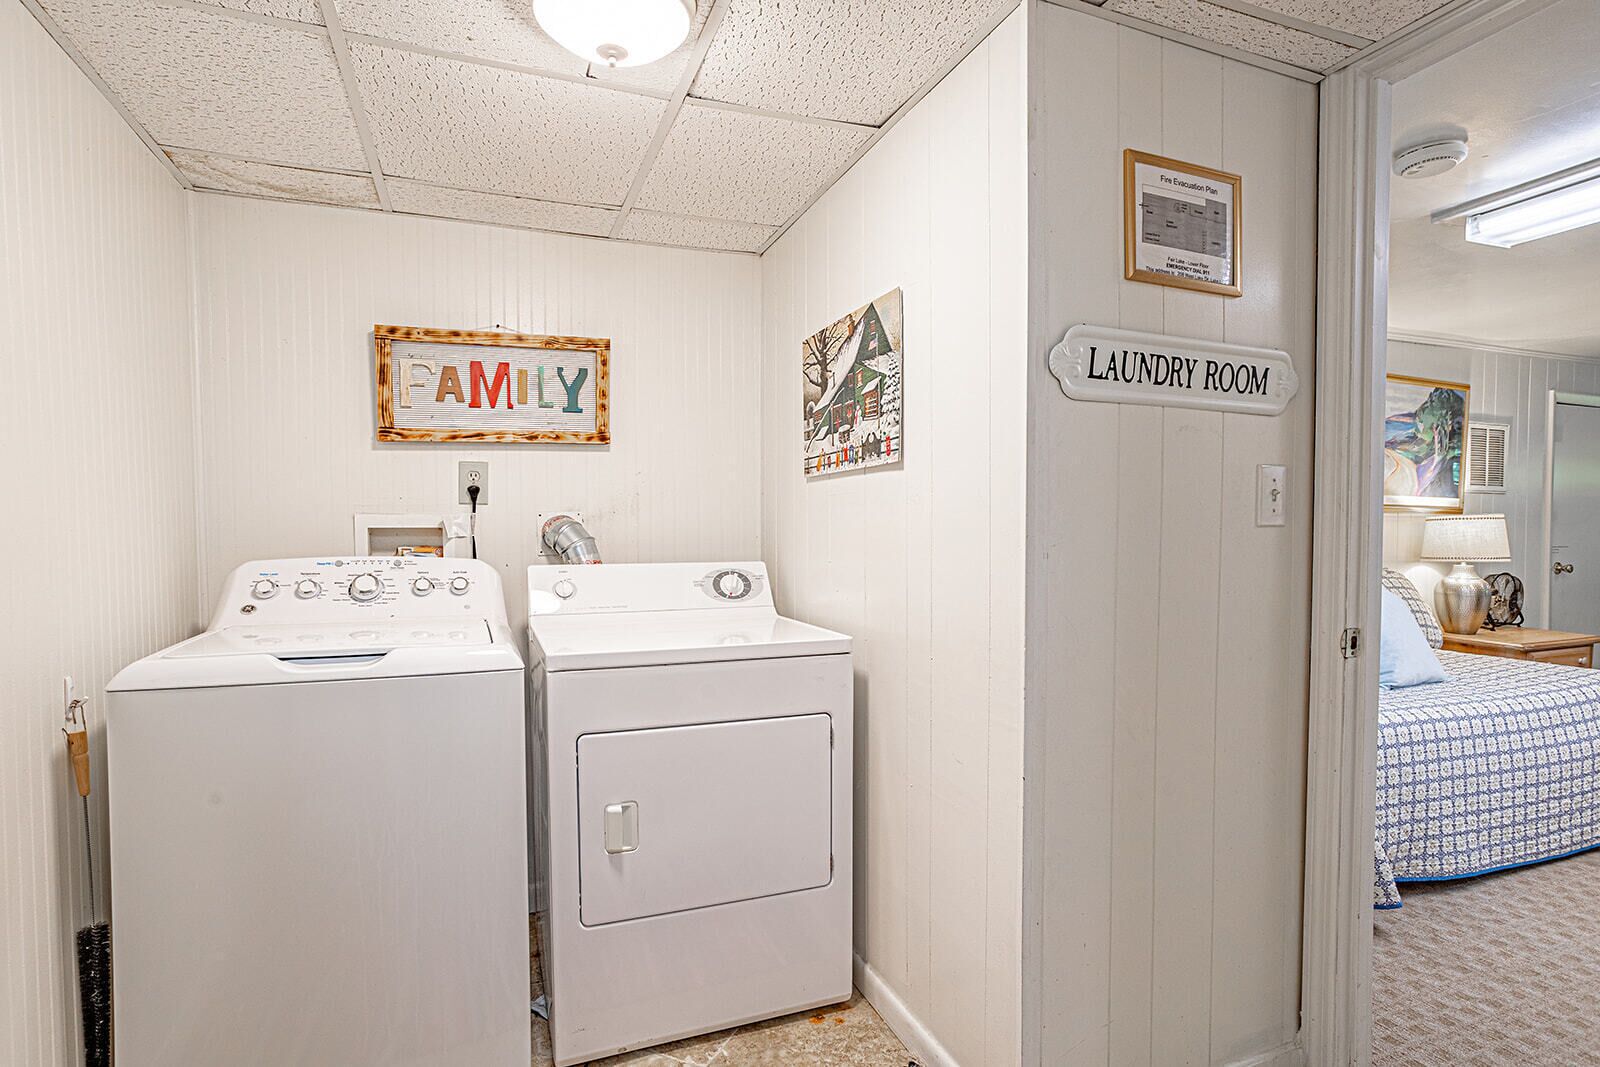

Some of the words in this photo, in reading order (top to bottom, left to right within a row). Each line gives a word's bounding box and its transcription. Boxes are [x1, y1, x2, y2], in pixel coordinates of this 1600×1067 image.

[1160, 174, 1172, 184] Fire
[1173, 178, 1204, 192] Evacuation
[1205, 186, 1218, 196] Plan
[1166, 263, 1192, 273] EMERGENCY
[399, 358, 588, 413] FAMILY
[1087, 346, 1199, 389] LAUNDRY
[1203, 360, 1270, 396] ROOM
